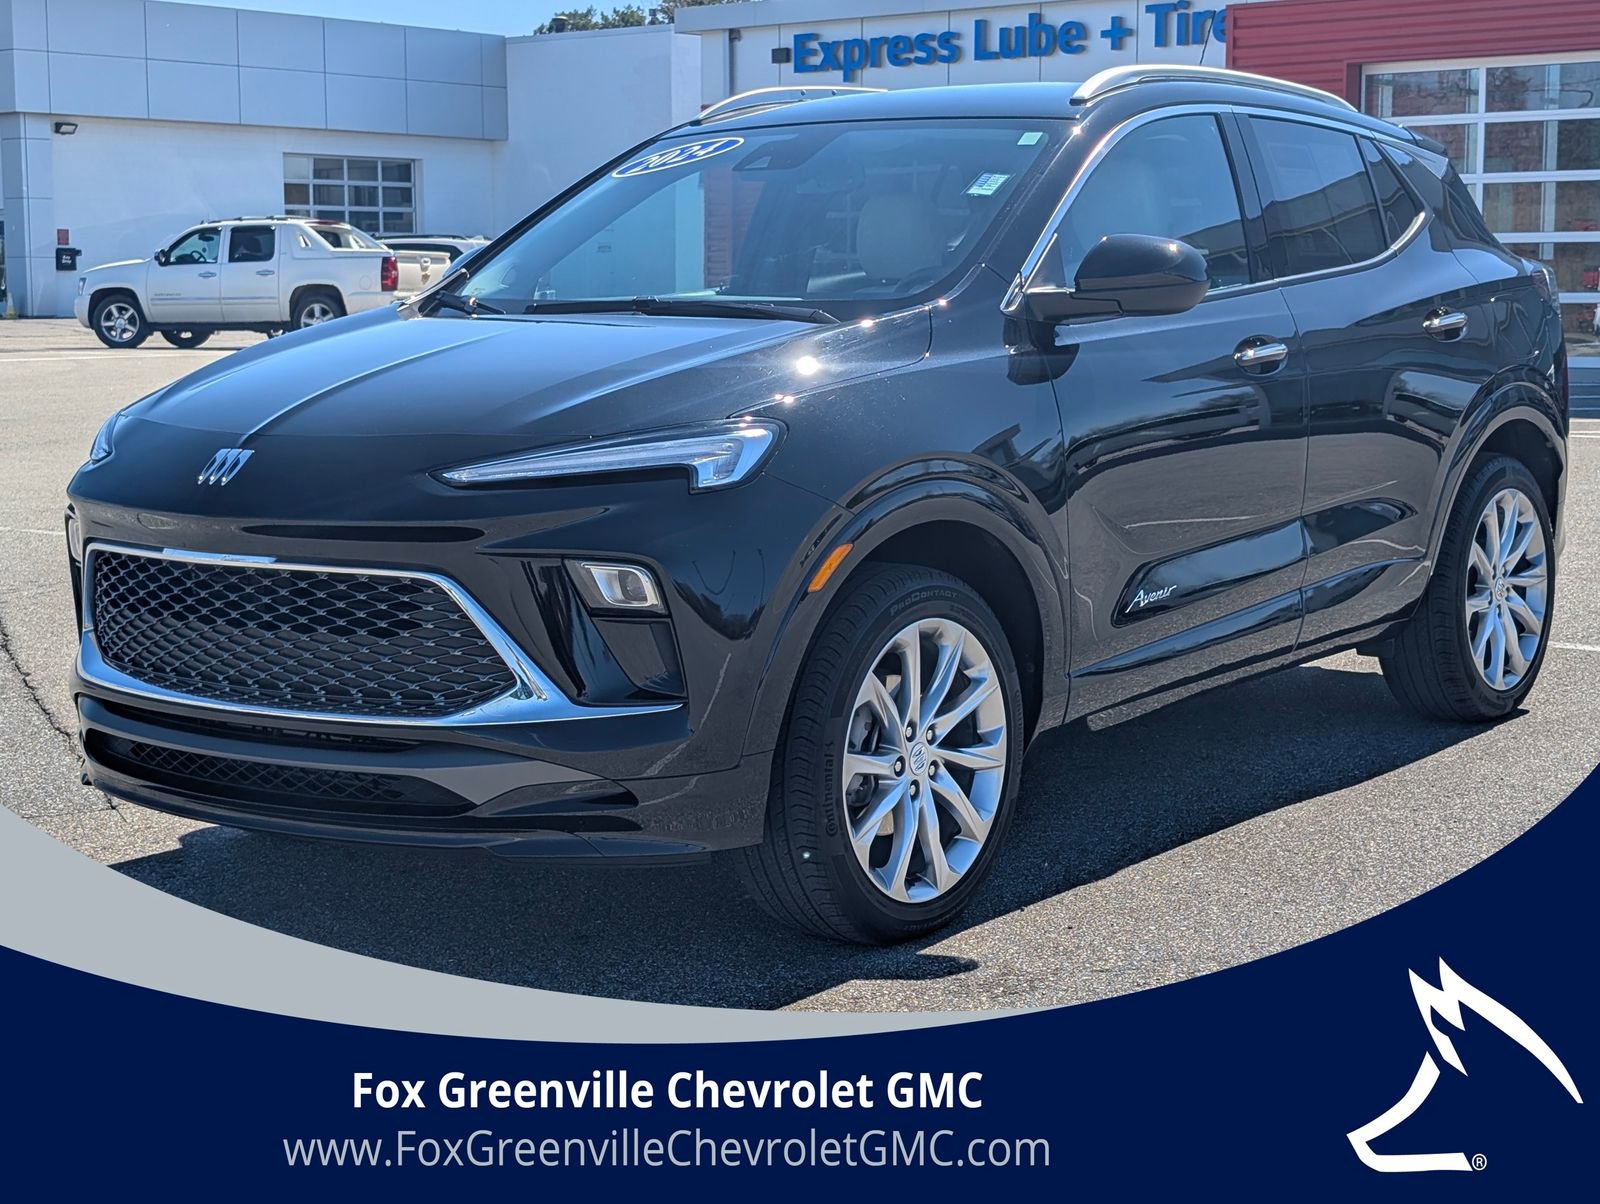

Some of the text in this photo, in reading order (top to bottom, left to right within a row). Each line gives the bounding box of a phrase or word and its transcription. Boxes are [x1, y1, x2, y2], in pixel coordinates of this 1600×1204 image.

[793, 30, 960, 83] Express
[973, 13, 1088, 61] Lube
[624, 139, 729, 175] 2024
[1125, 585, 1177, 613] Avenir
[822, 753, 839, 837] Continental
